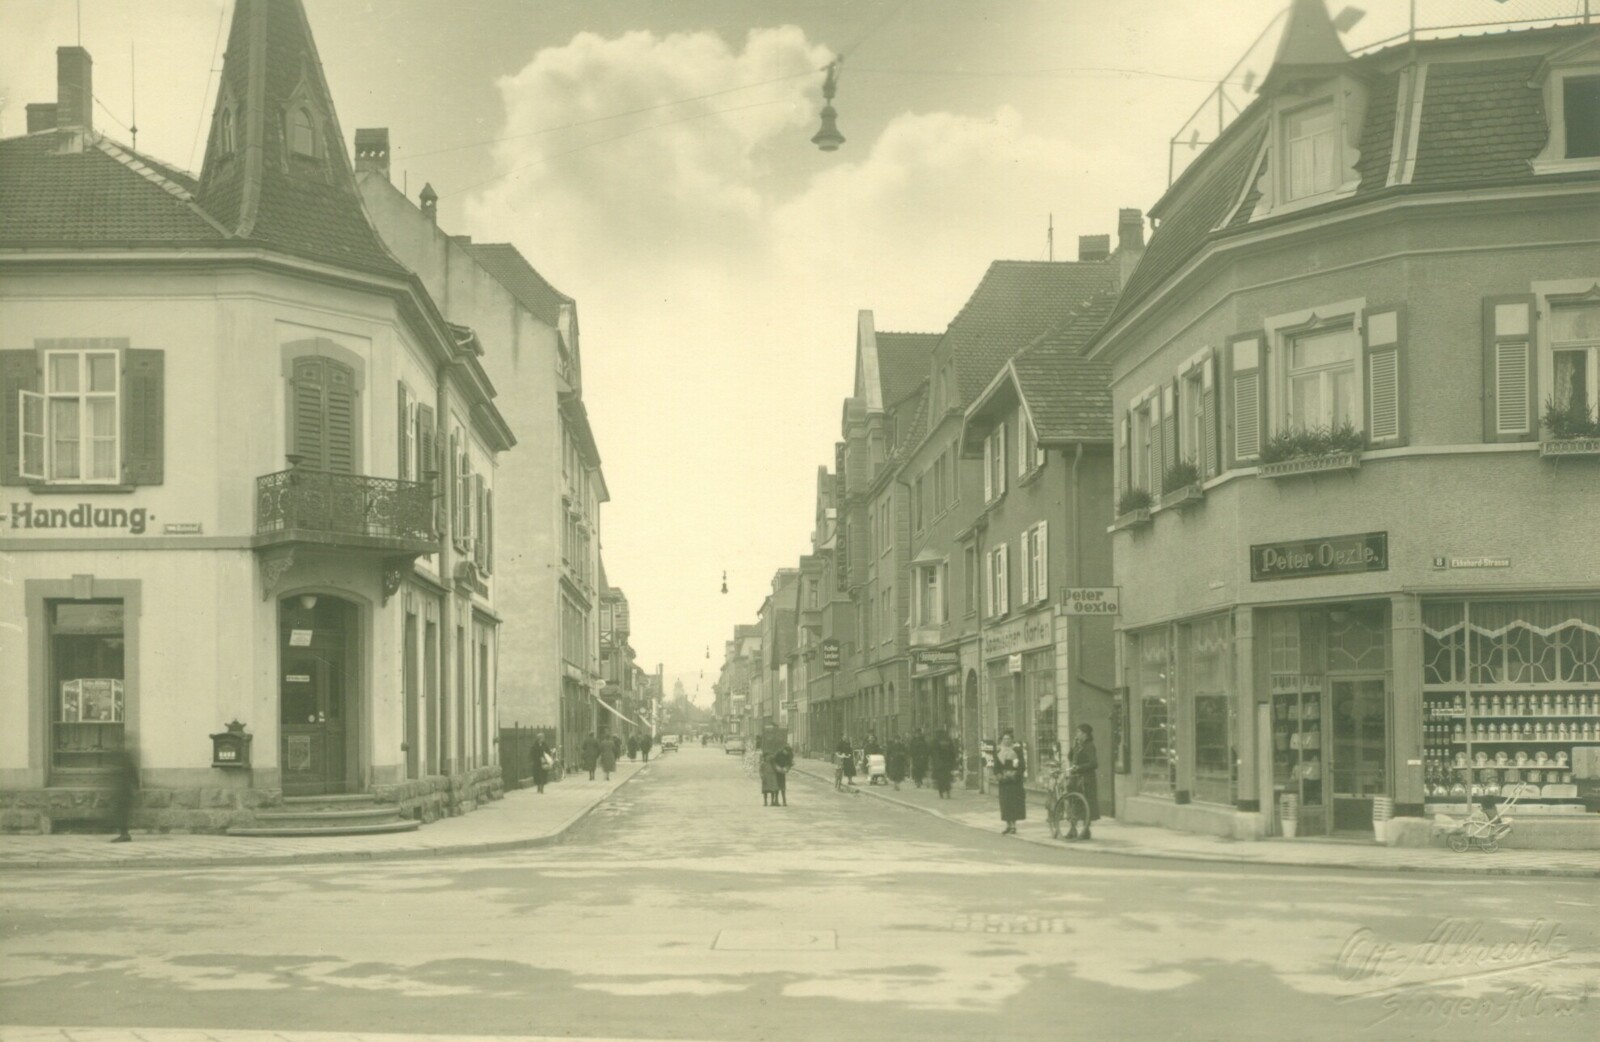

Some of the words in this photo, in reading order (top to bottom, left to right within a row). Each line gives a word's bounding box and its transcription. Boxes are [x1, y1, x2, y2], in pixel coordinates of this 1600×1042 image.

[1262, 548, 1314, 572] Peter
[1436, 558, 1443, 566] 8
[1062, 589, 1104, 607] Peter
[1074, 601, 1117, 613] Oexle
[1024, 621, 1049, 644] Garten
